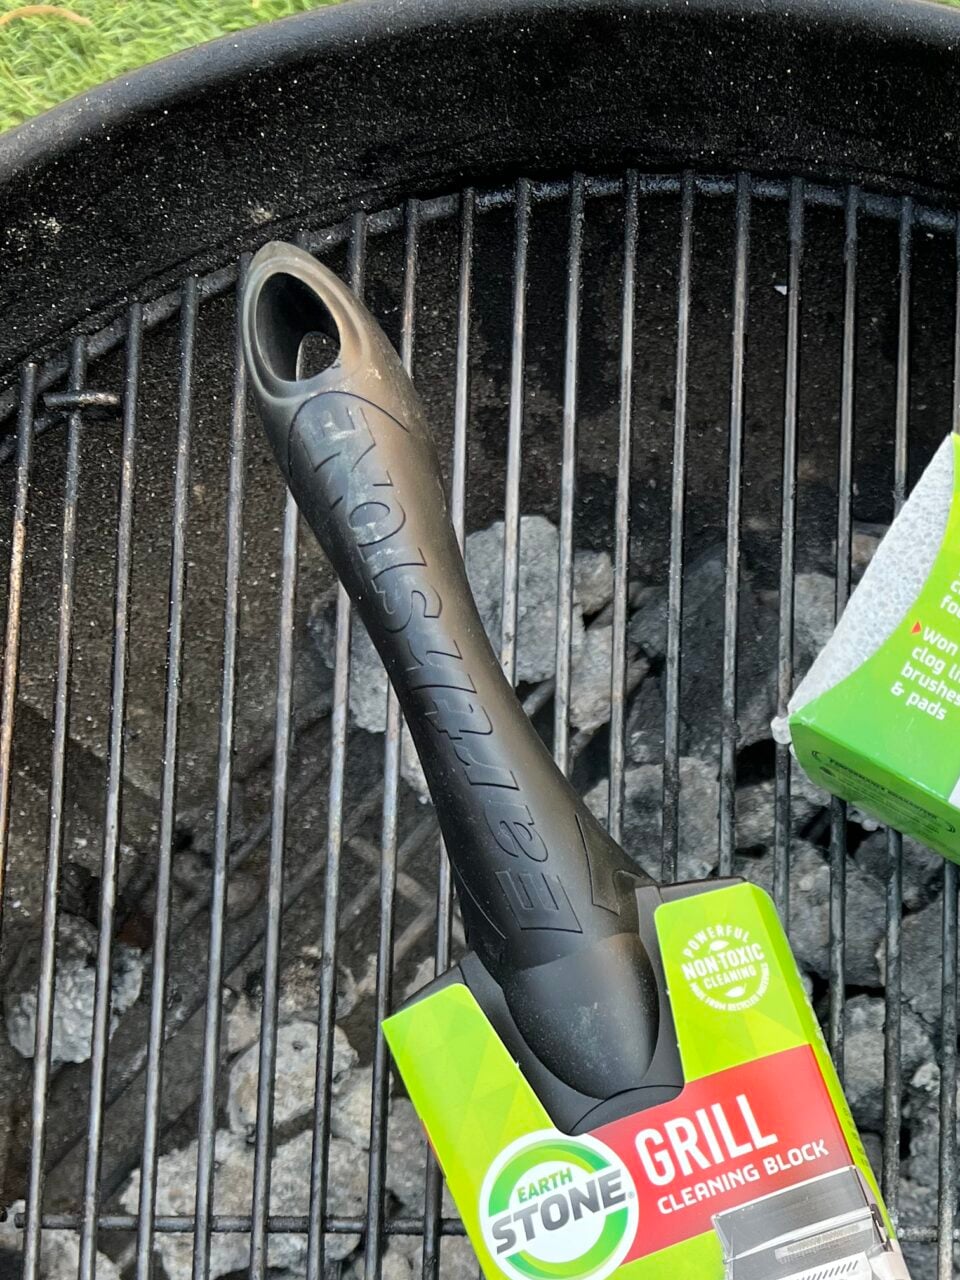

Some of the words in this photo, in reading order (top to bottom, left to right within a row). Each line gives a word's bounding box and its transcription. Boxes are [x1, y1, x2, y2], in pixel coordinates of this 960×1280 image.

[911, 646, 946, 675] clog
[890, 681, 905, 697] &
[905, 691, 947, 720] pads
[682, 924, 749, 958] POWERFUL
[703, 964, 757, 990] CLEANING
[635, 1094, 778, 1187] GRILL
[517, 1167, 573, 1204] EARTH
[657, 1164, 761, 1216] CLEANING
[762, 1139, 829, 1175] BLOCK
[491, 1169, 627, 1255] STONE
